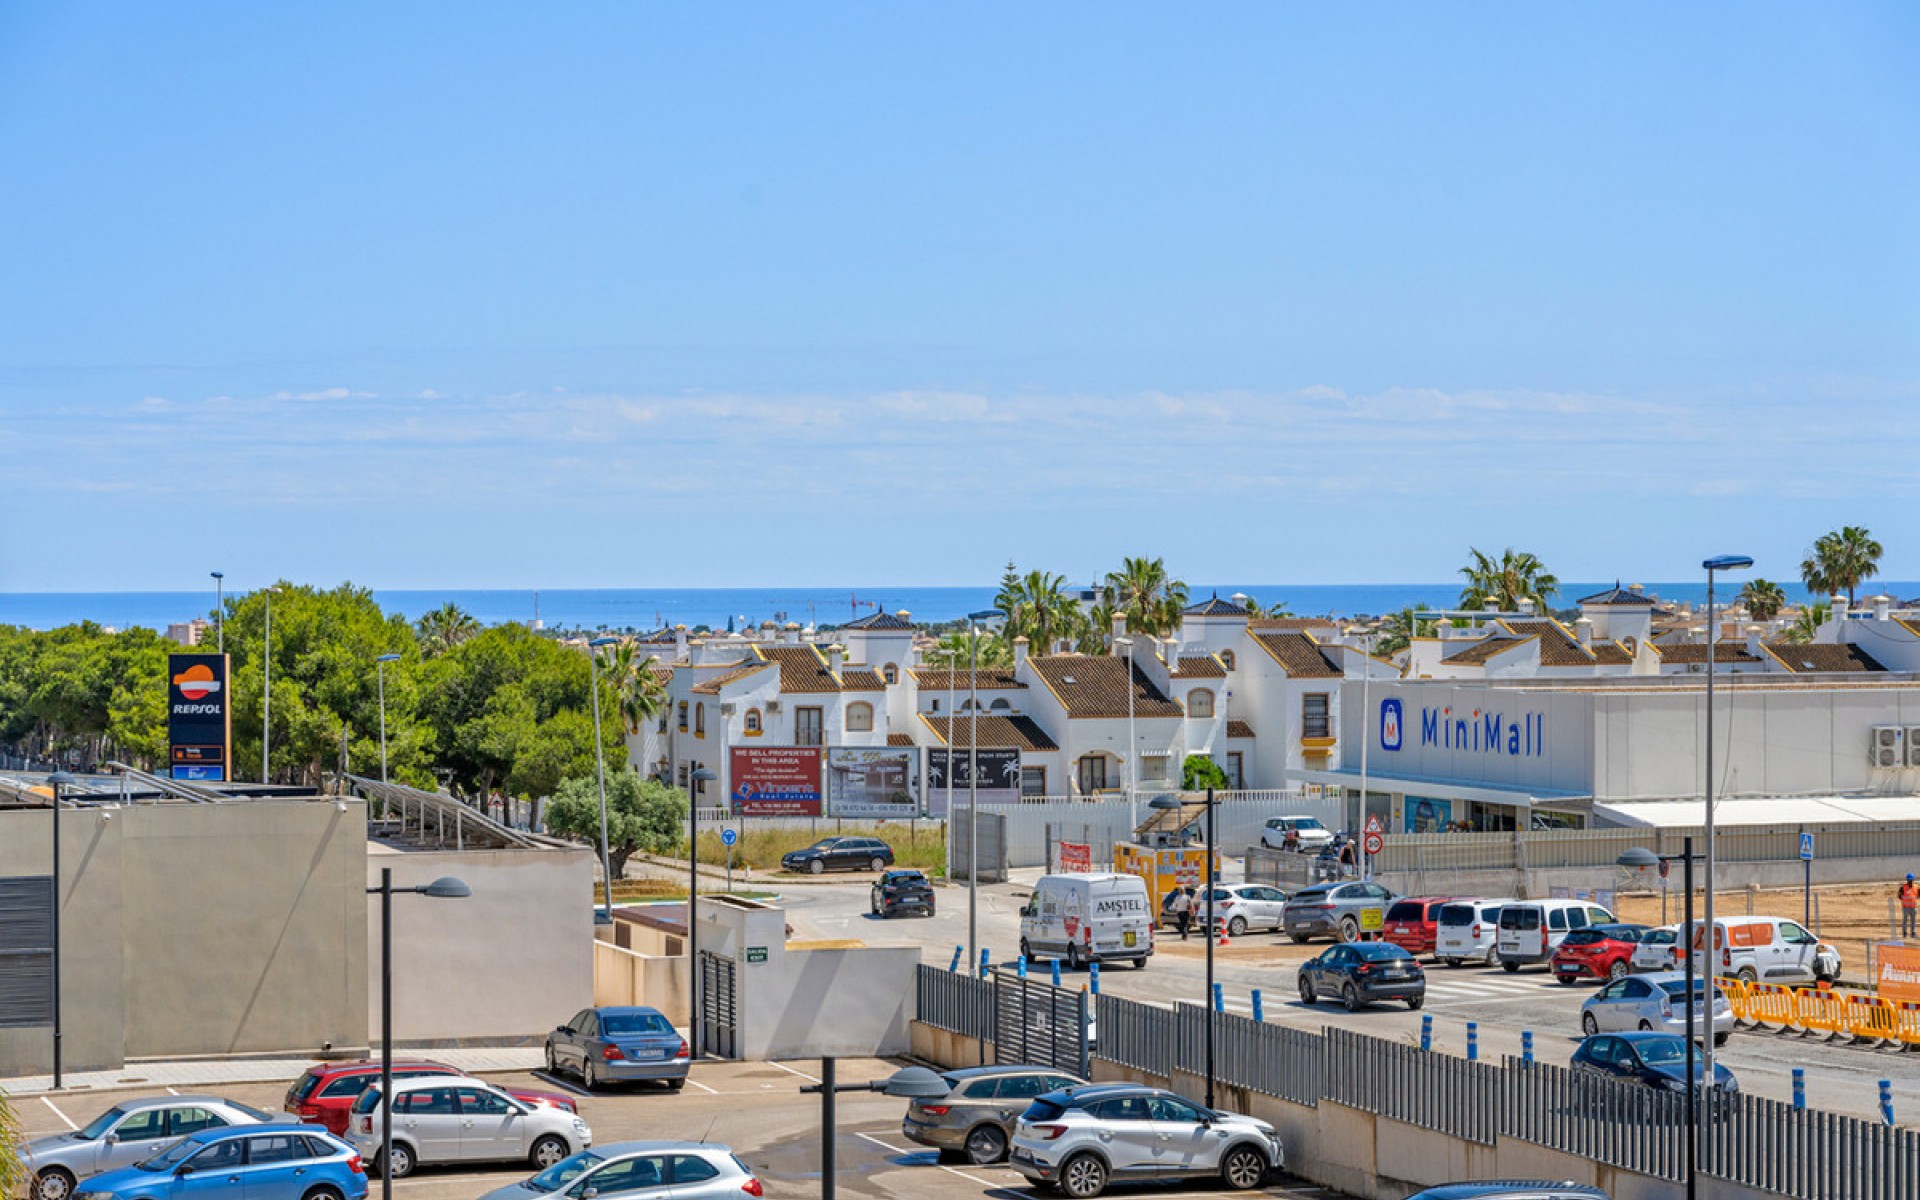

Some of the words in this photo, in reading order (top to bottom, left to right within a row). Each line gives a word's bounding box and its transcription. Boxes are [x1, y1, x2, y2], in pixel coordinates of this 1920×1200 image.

[173, 704, 221, 714] REPSOL
[1386, 722, 1396, 738] M
[1422, 706, 1542, 757] MiniMall
[1368, 840, 1380, 848] 30
[1096, 899, 1142, 912] AMSTEL
